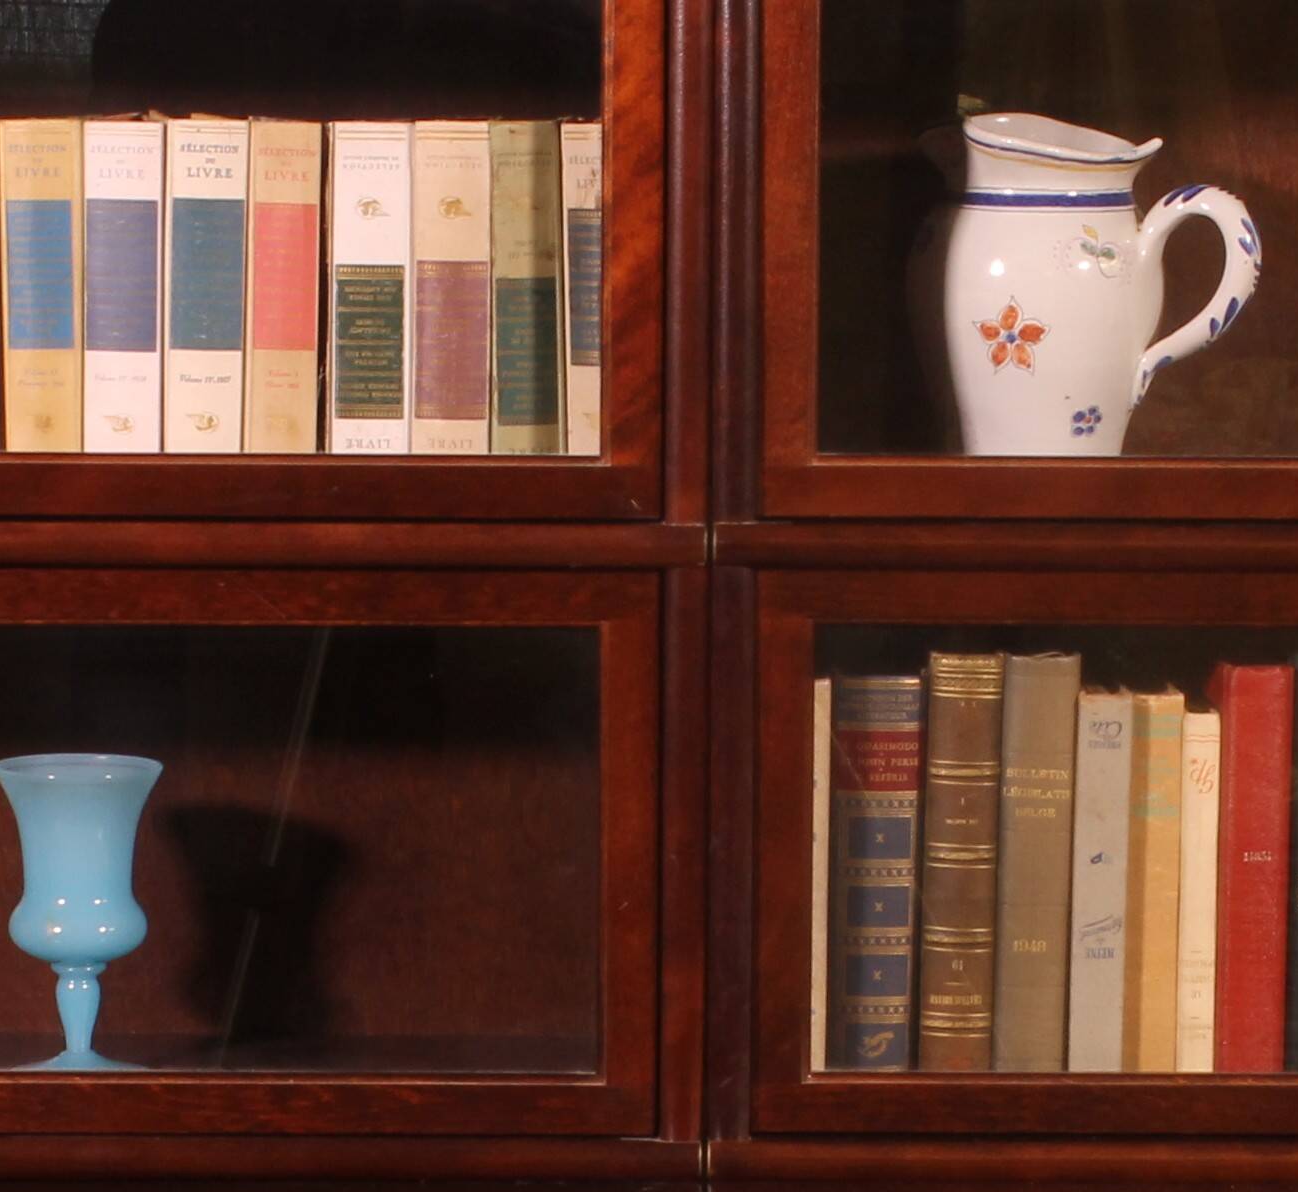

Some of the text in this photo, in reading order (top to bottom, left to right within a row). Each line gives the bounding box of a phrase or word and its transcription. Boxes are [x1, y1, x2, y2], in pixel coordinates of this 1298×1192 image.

[180, 143, 239, 154] SÉLECTION
[15, 167, 62, 178] LIVRE
[99, 168, 145, 180] LIVRE
[187, 167, 233, 179] LIVRE
[264, 170, 310, 182] LIVRE
[345, 437, 391, 449] LIVRE
[427, 437, 473, 449] LIVRE
[1006, 767, 1071, 780] BULLETIN
